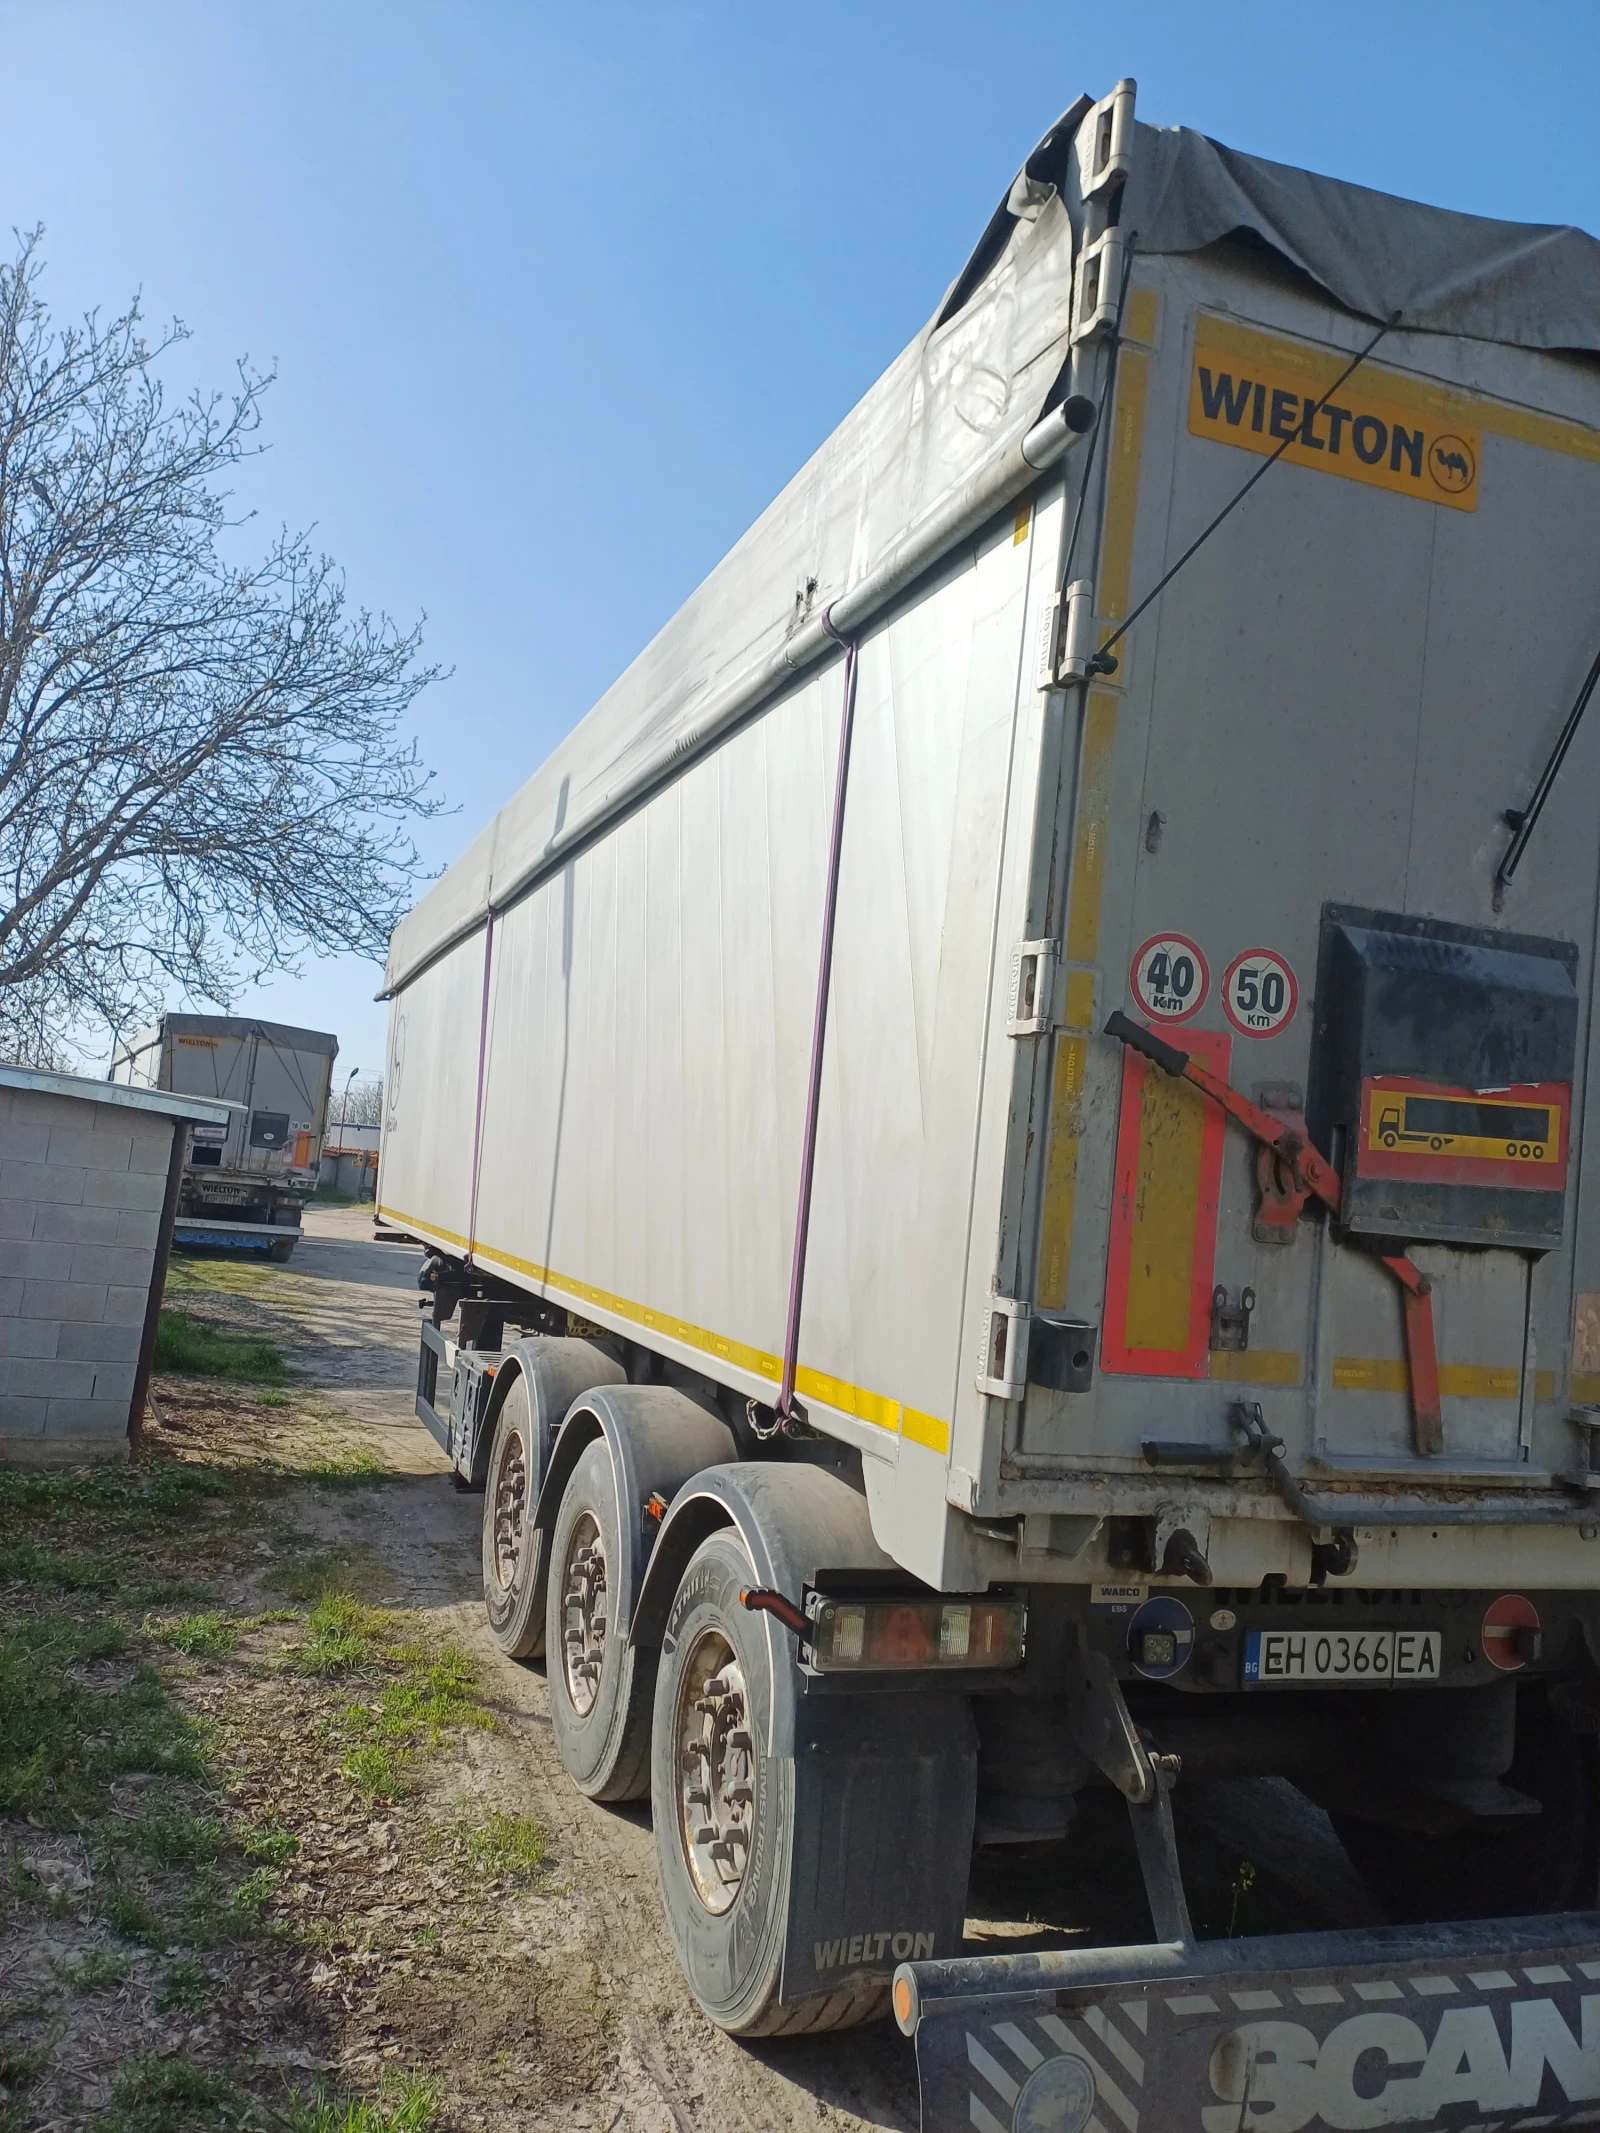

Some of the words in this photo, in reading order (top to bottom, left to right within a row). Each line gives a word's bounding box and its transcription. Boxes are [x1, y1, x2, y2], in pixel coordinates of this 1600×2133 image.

[1197, 365, 1425, 478] WIELTON
[1146, 952, 1194, 996] 40
[1236, 969, 1284, 1014] 50
[178, 1037, 211, 1048] WIELTON
[1064, 1052, 1076, 1093] WIELTON
[202, 1184, 240, 1195] WIELTON
[1101, 1587, 1140, 1597] WABCO
[1111, 1605, 1127, 1613] EBS
[1244, 1661, 1258, 1674] BG
[1265, 1636, 1306, 1674] EH
[1314, 1636, 1390, 1674] 0366
[1397, 1637, 1435, 1673] EA
[813, 1931, 936, 1971] WIELTON
